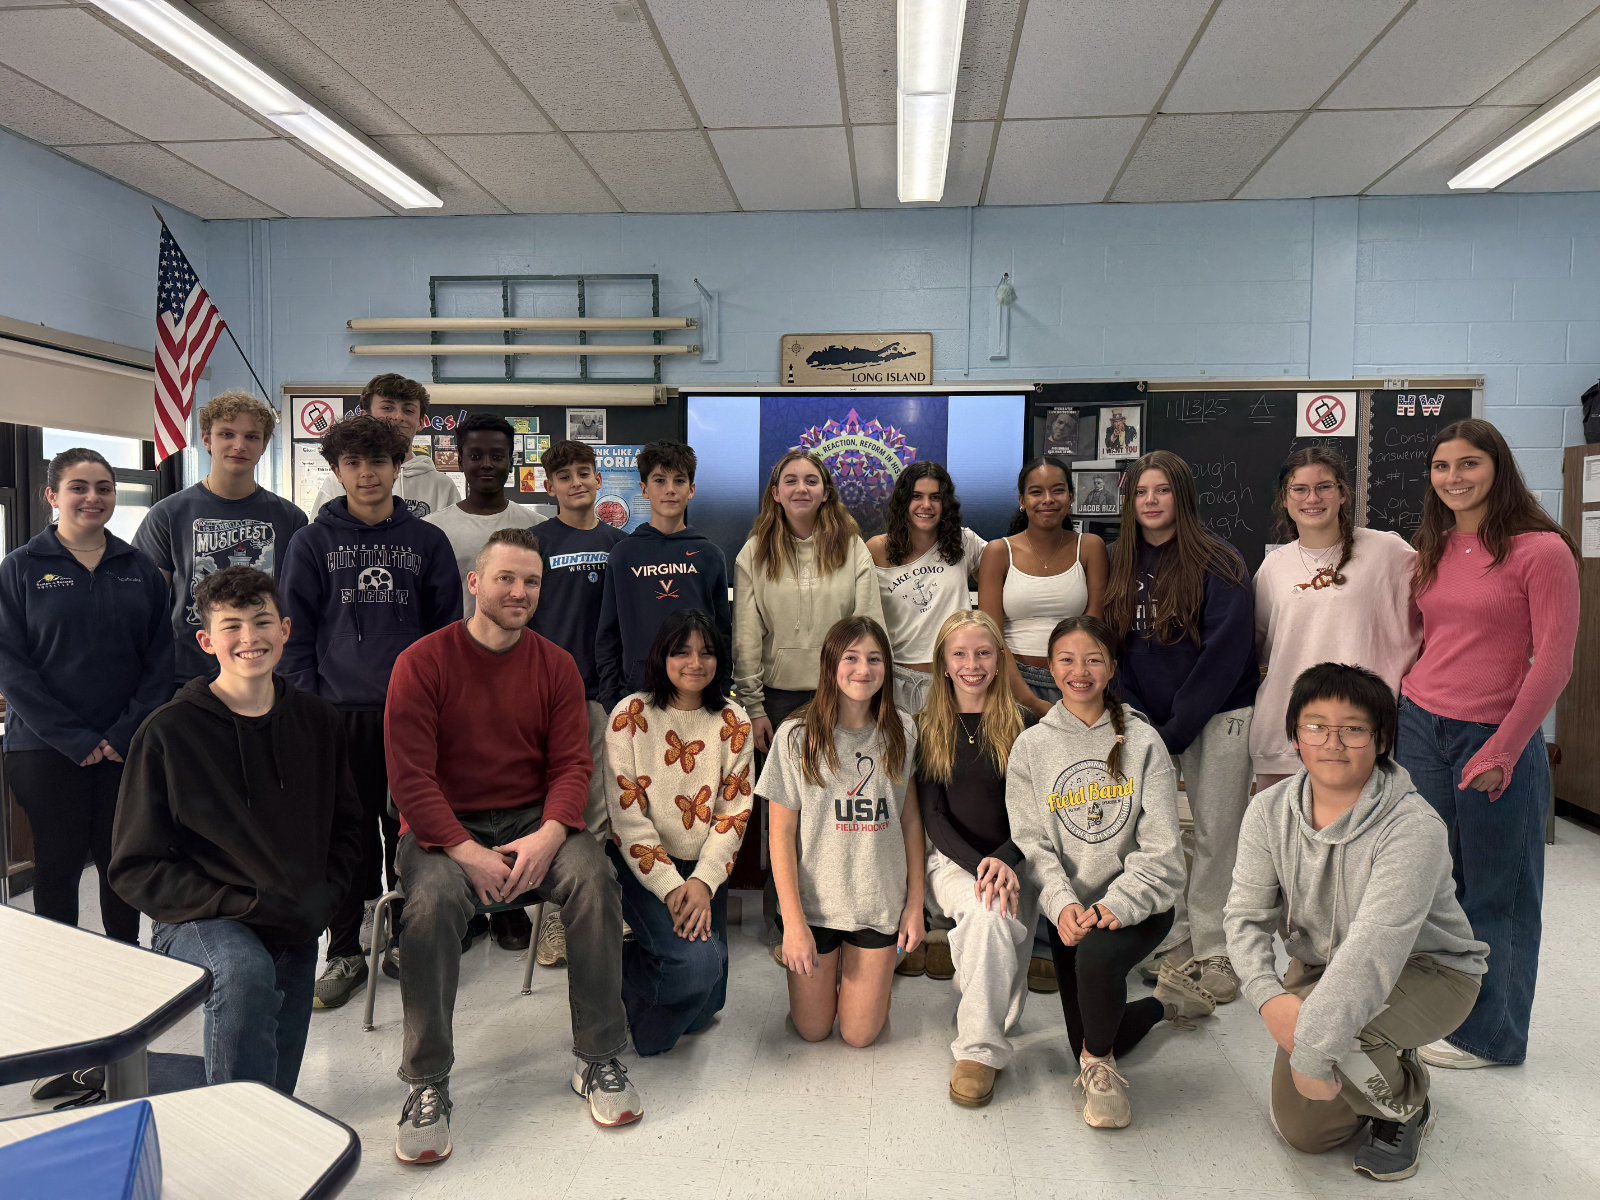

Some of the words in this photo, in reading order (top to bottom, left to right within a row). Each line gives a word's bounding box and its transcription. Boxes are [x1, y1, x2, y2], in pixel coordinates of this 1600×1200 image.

[852, 372, 883, 383] LONG
[886, 371, 926, 383] ISLAND
[1249, 393, 1276, 416] A
[1396, 394, 1445, 417] HW
[423, 409, 468, 432] es!
[594, 448, 610, 456] NK
[612, 448, 633, 456] LIKE
[822, 438, 858, 453] REACTION,
[859, 439, 886, 457] REFORM
[884, 454, 894, 463] IN
[890, 461, 902, 475] HIS
[1125, 445, 1138, 453] YOU
[1079, 504, 1100, 512] JACOB
[1101, 504, 1116, 512] RIZZ
[338, 544, 366, 552] BLUE
[326, 549, 422, 576] HUNTINGTON
[551, 552, 610, 568] HUNTING
[630, 562, 699, 578] VIRGINIA
[887, 572, 912, 593] LAKE
[912, 565, 945, 577] COMO
[1046, 787, 1087, 812] Field
[1087, 777, 1135, 801] Band
[834, 797, 890, 822] USA
[835, 823, 859, 832] FIELD
[861, 821, 890, 832] HOCKEY
